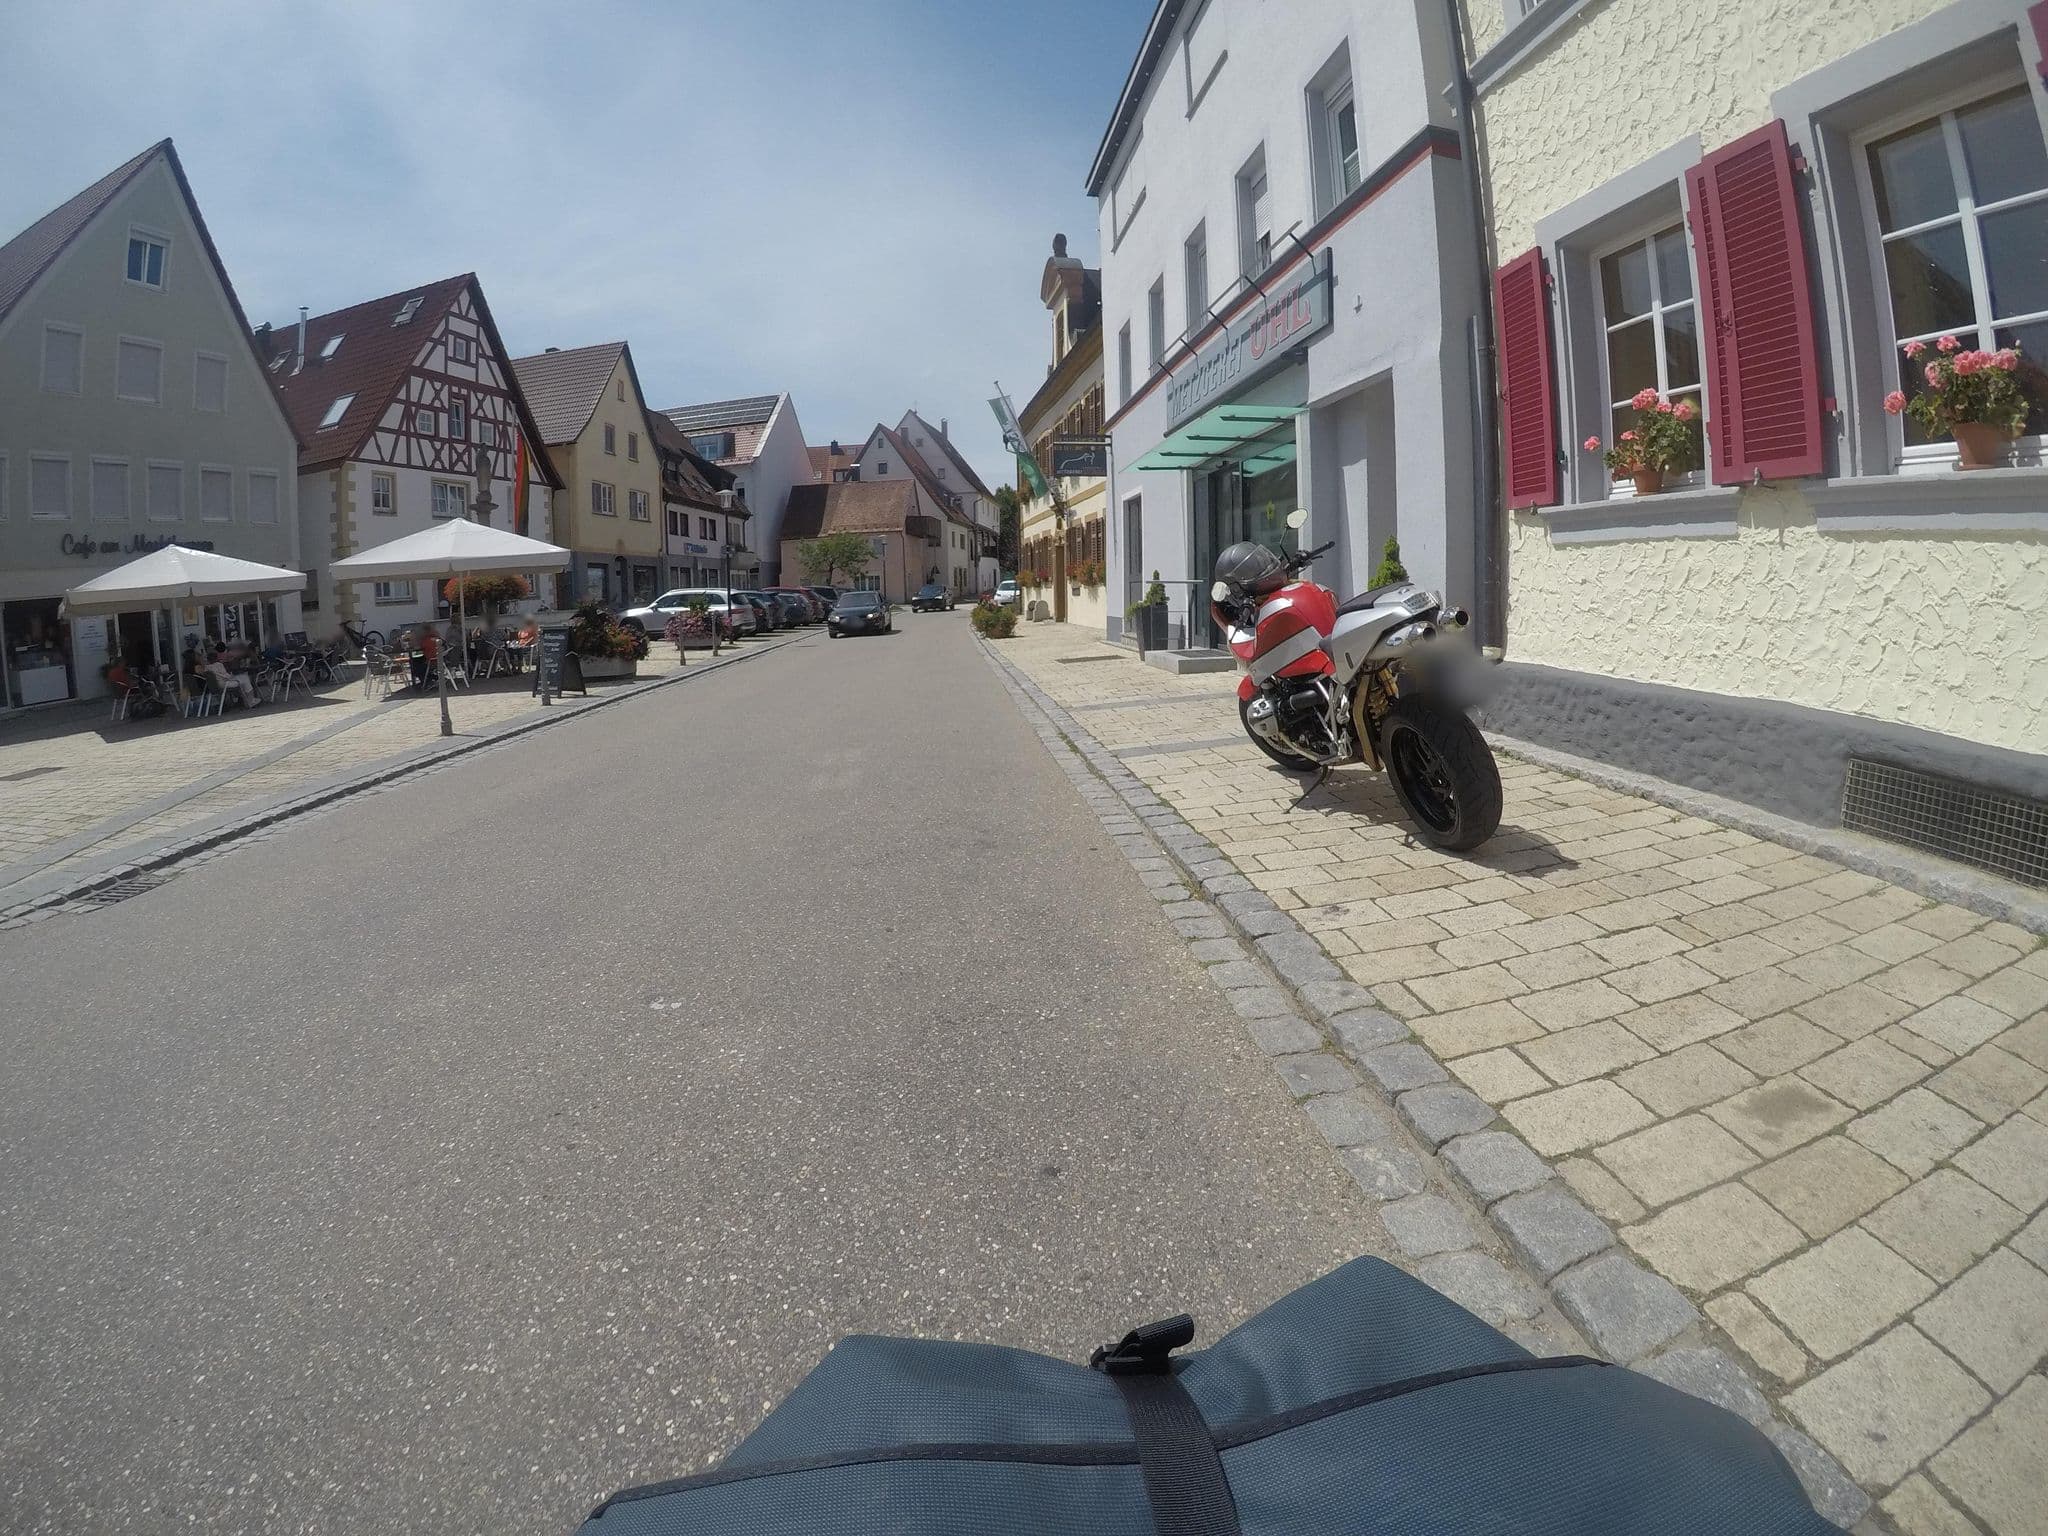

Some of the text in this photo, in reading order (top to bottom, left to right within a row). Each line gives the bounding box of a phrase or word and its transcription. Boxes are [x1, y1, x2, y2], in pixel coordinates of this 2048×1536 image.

[1172, 284, 1312, 418] METZGEREI UHL
[100, 542, 120, 553] am
